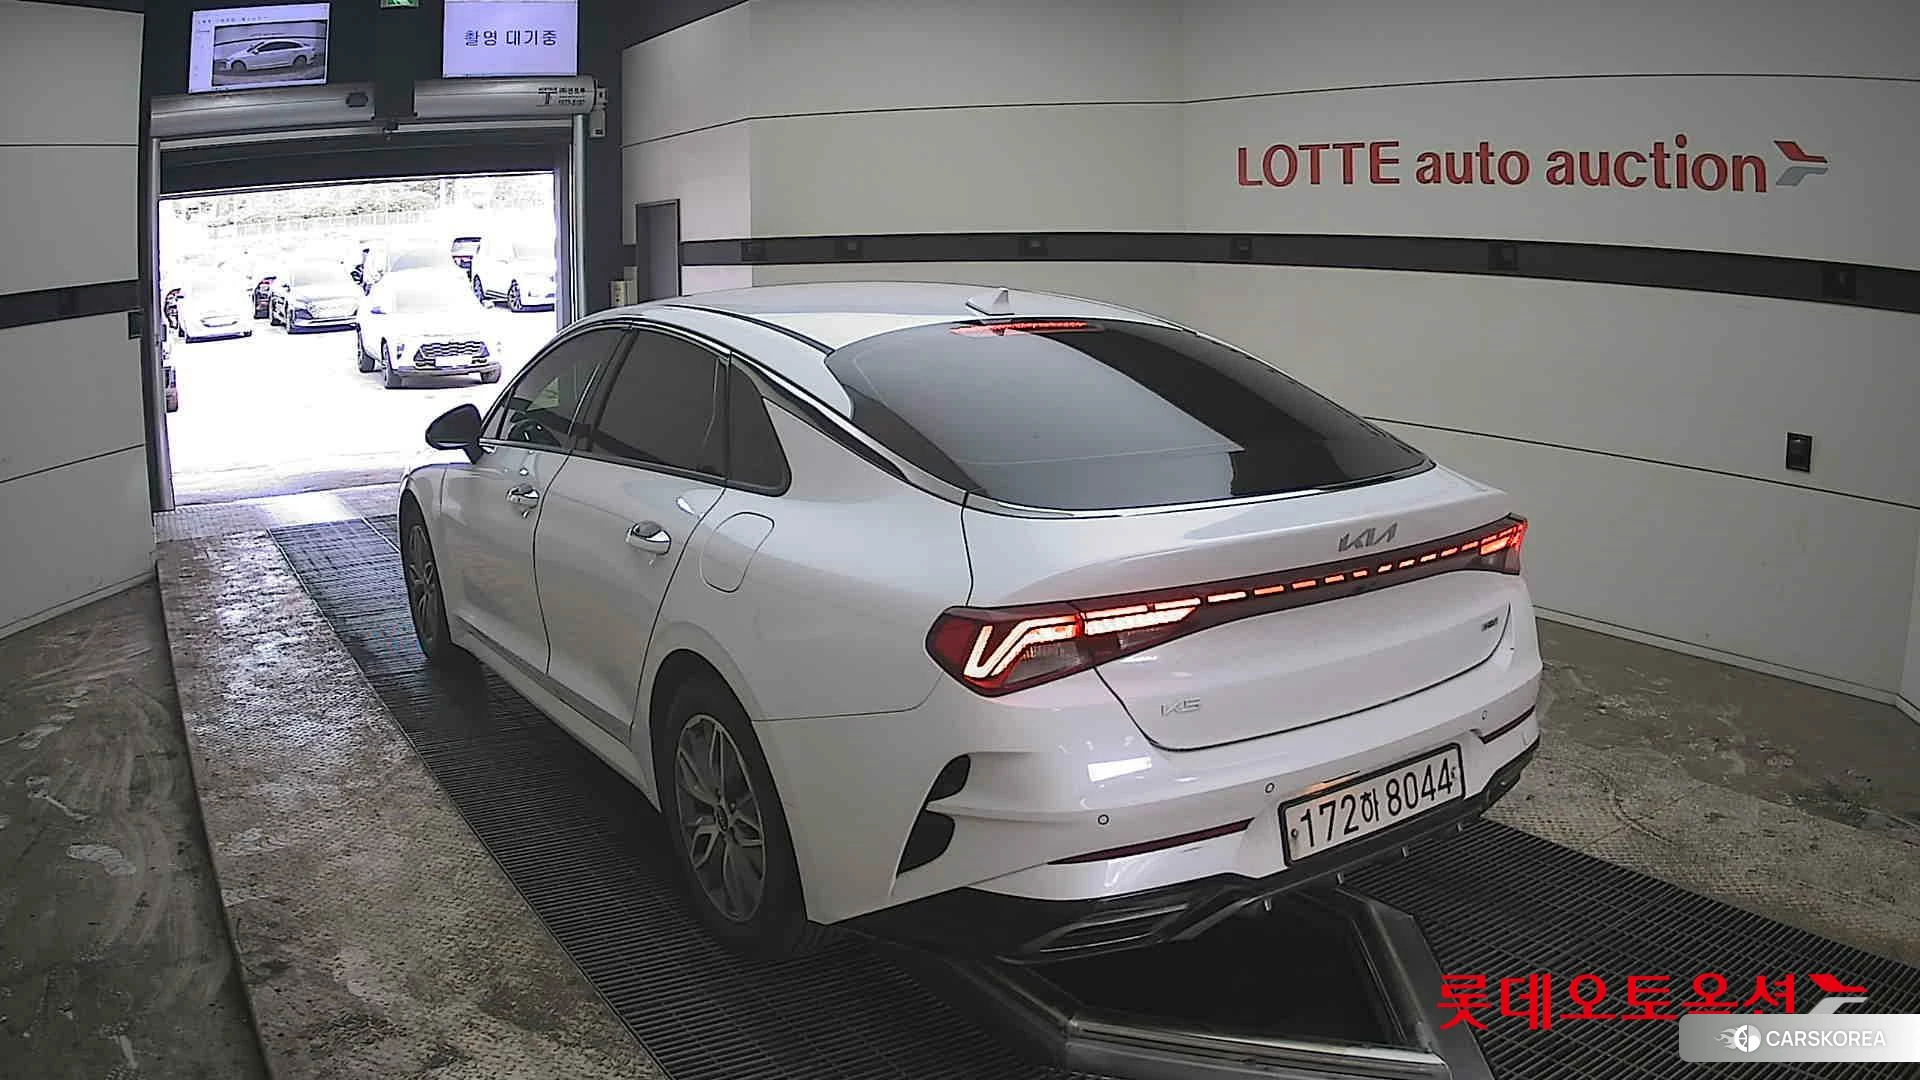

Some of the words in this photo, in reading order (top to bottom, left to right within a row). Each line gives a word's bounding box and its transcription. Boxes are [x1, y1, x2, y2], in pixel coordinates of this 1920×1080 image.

[464, 29, 498, 46] 촬영
[506, 30, 558, 46] 대기중
[1237, 141, 1398, 188] LOTTE
[1415, 140, 1530, 185] auto
[1545, 133, 1767, 193] auction
[1160, 698, 1201, 717] K5
